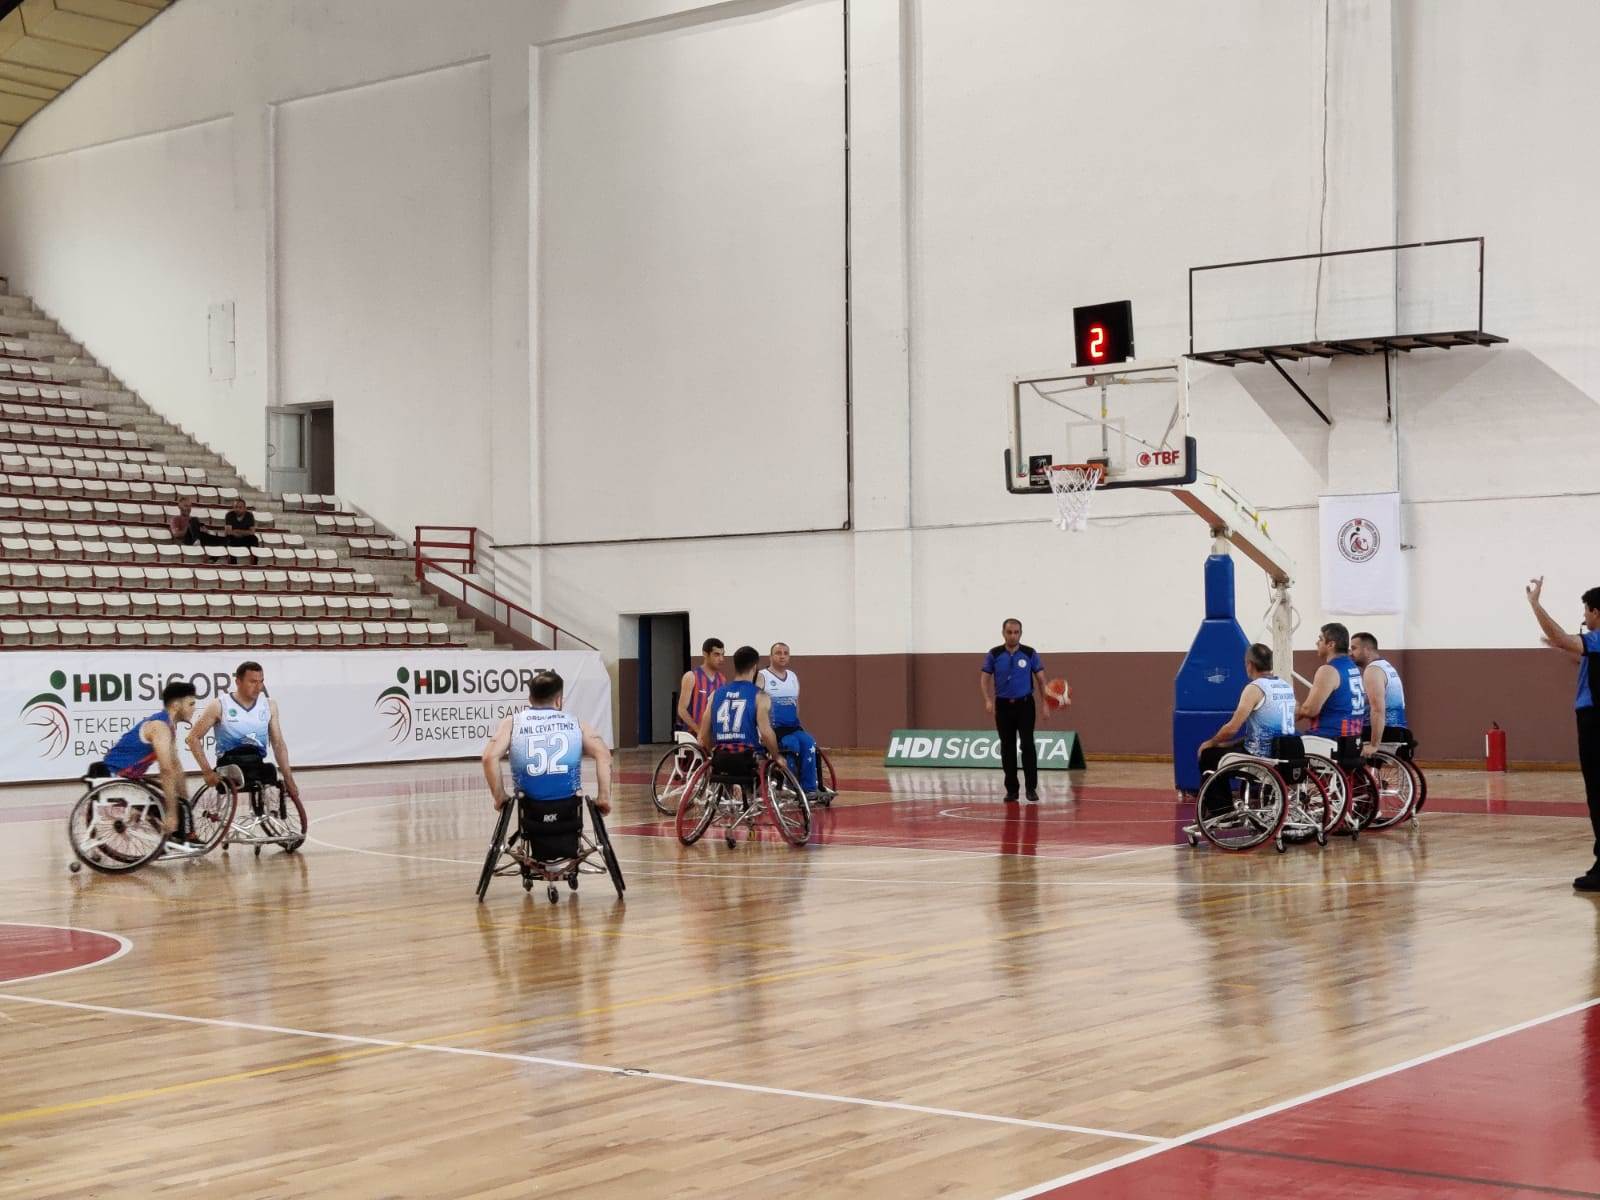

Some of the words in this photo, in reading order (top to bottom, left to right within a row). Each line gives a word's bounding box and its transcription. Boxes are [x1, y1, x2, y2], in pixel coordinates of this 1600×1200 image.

[1090, 327, 1104, 358] 2
[1152, 451, 1180, 465] TBF
[73, 673, 133, 702] HDI
[414, 669, 459, 694] HDI
[415, 703, 494, 722] TEKERLEKLİ
[716, 699, 747, 733] 47
[415, 725, 493, 741] BASKETBOL
[526, 732, 569, 776] 52
[887, 737, 943, 758] HDI
